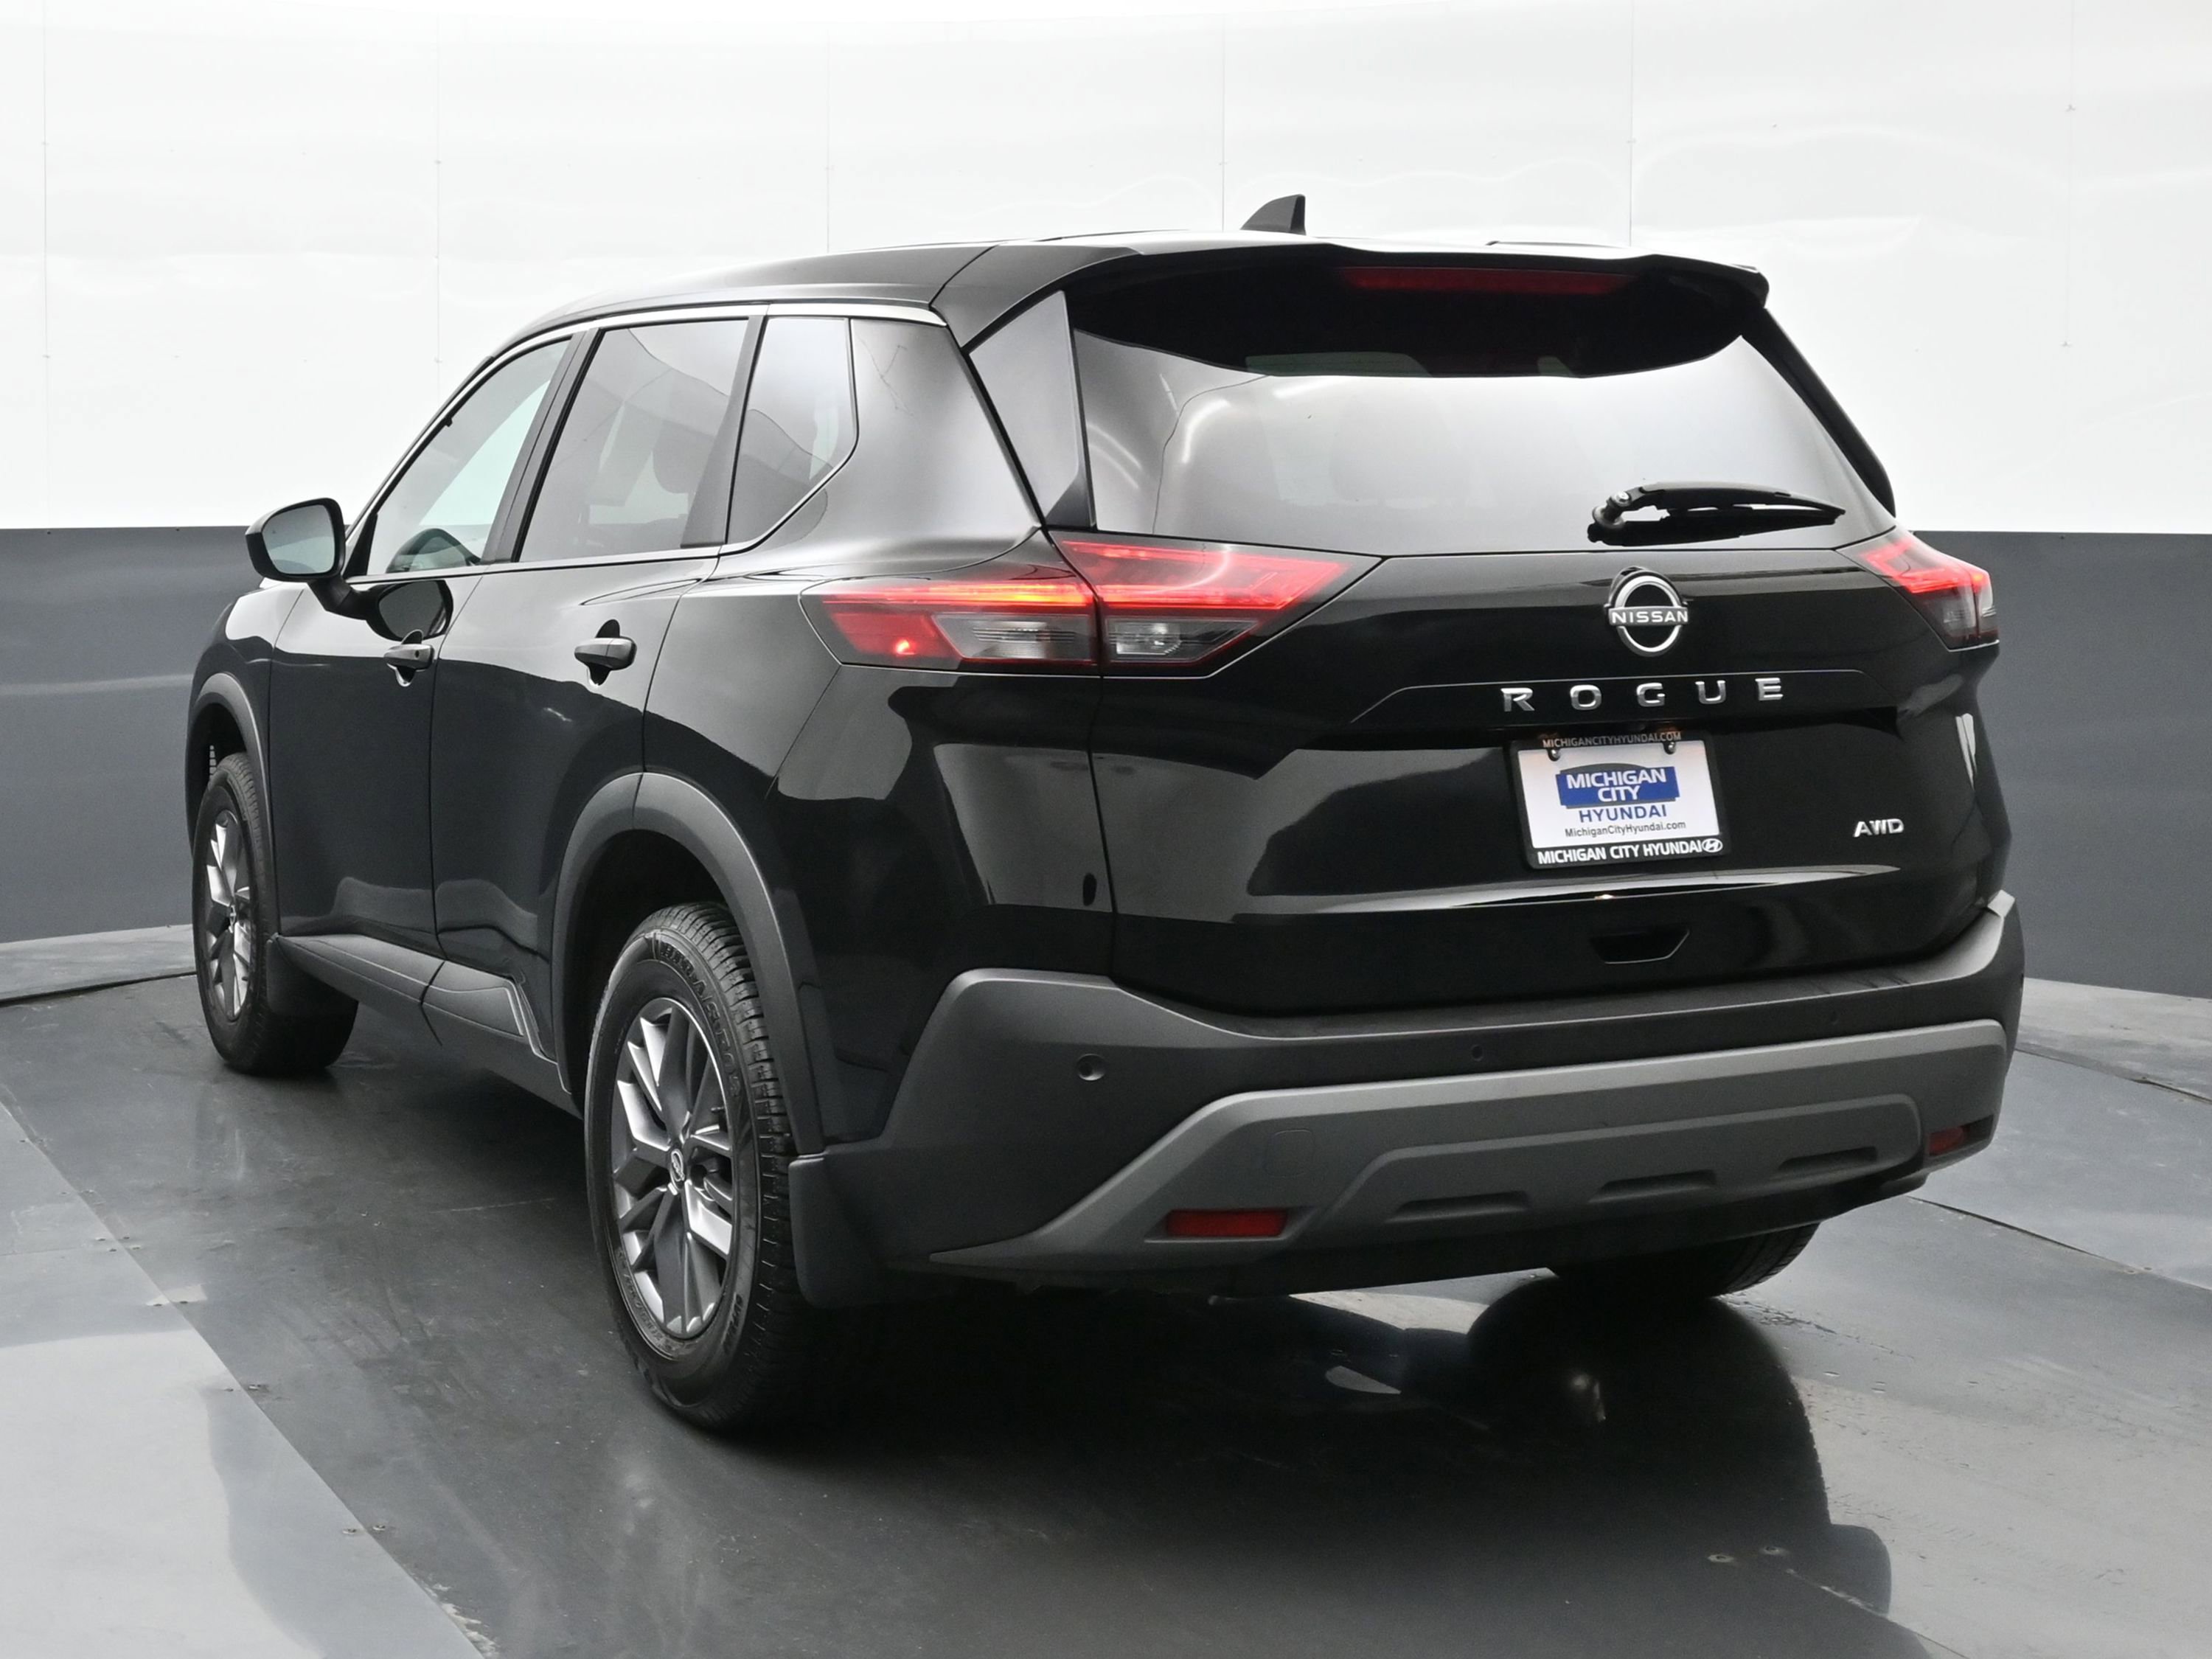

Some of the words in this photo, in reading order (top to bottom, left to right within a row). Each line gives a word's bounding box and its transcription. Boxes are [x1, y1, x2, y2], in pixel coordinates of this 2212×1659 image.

[1611, 609, 1688, 624] NISSAN
[1500, 678, 1783, 712] ROGUE
[1543, 732, 1682, 748] MICHIGANCITYHYUNDAI.COM
[1566, 768, 1666, 789] MICHIGAN
[1598, 785, 1641, 802] CITY
[1579, 804, 1666, 823] HYUNDAI
[1565, 821, 1686, 838] MichiganCityHyundai.com
[1853, 818, 1904, 838] AWD
[1537, 847, 1607, 864] MICHIGAN
[1610, 844, 1640, 860] CITY
[1644, 840, 1703, 856] HYUNDAI
